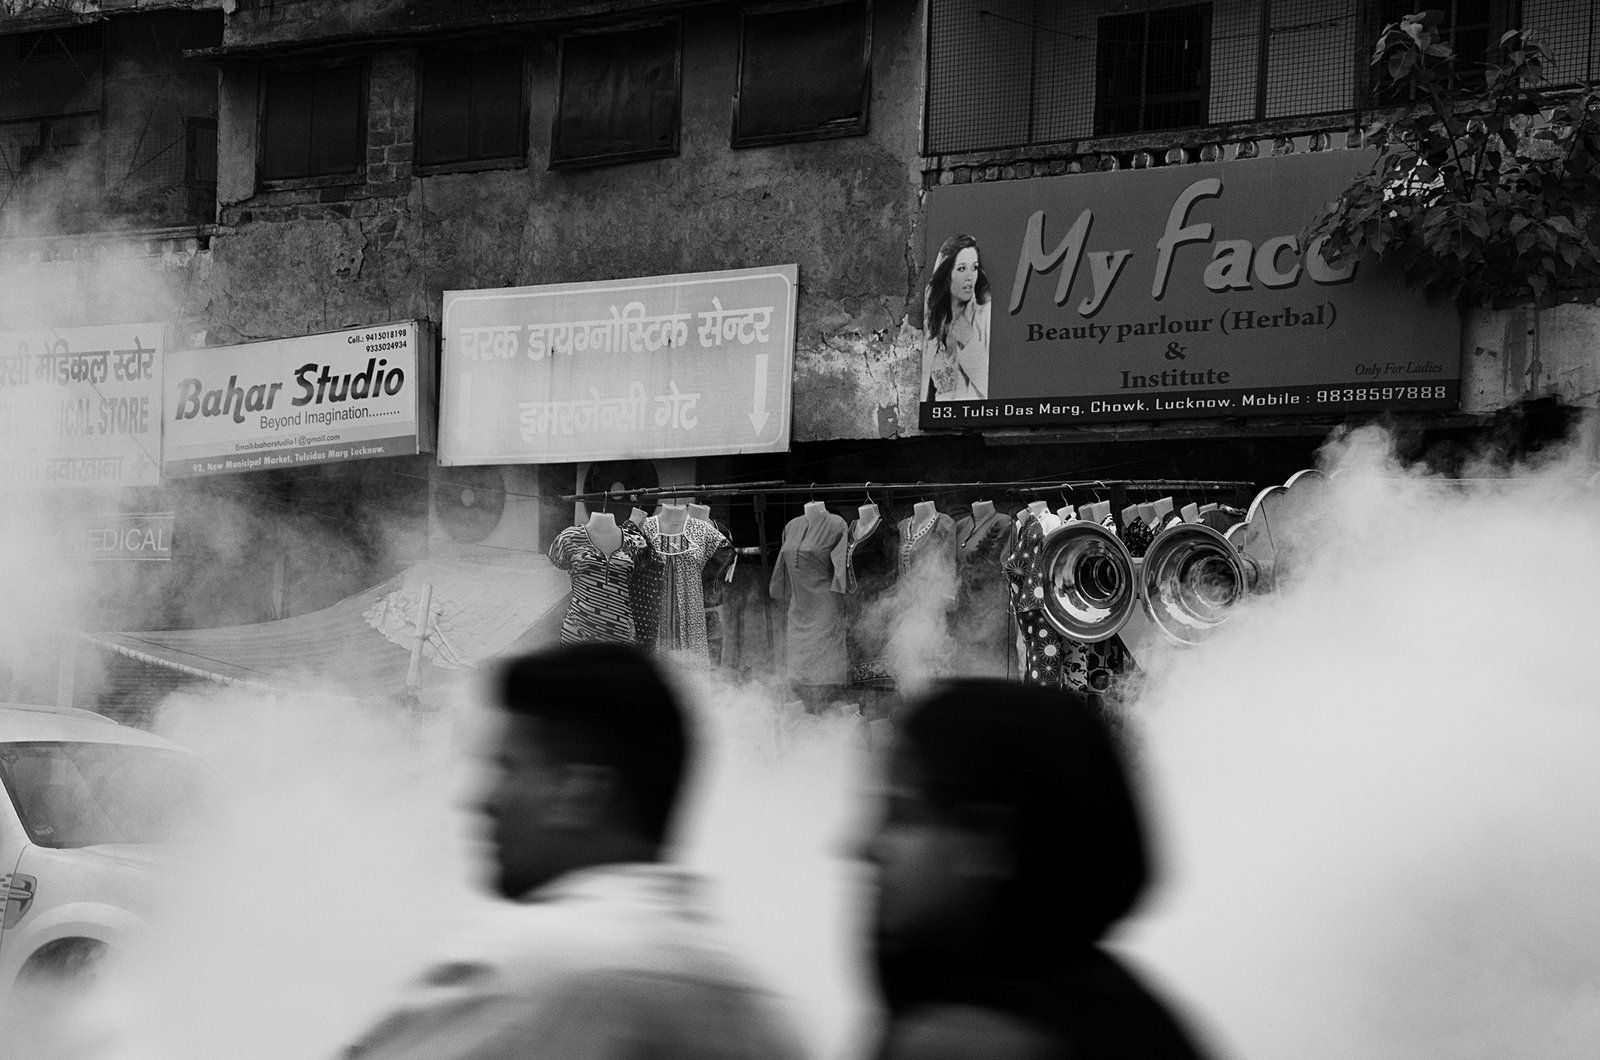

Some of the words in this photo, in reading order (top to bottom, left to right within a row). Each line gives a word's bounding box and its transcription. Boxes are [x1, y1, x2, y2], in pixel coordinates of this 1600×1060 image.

[1008, 208, 1134, 319] My
[365, 328, 407, 341] 9415018198
[458, 325, 522, 361] चरक
[697, 296, 775, 348] सेन्टर
[1026, 319, 1112, 344] Beauty
[1116, 314, 1213, 343] parlour
[1220, 301, 1337, 335] (Herbal)
[113, 336, 156, 382] स्टोर
[365, 340, 407, 353] 9335024934
[1164, 341, 1187, 360] &
[1120, 367, 1230, 389] Institute
[1355, 363, 1381, 379] Only
[1384, 362, 1404, 374] For
[1406, 361, 1442, 373] Ladies
[175, 374, 283, 424] Bahar
[291, 357, 405, 406] Studio
[654, 380, 701, 431] गेट
[962, 404, 999, 417] Tulsi
[1004, 404, 1034, 416] Das
[1242, 392, 1300, 406] Mobile
[1317, 386, 1446, 402] 9838597888
[99, 396, 149, 434] STORE
[260, 412, 301, 431] Beyond
[225, 457, 262, 469] Municipal
[295, 451, 326, 462] Tulsidas
[328, 449, 348, 459] Marg
